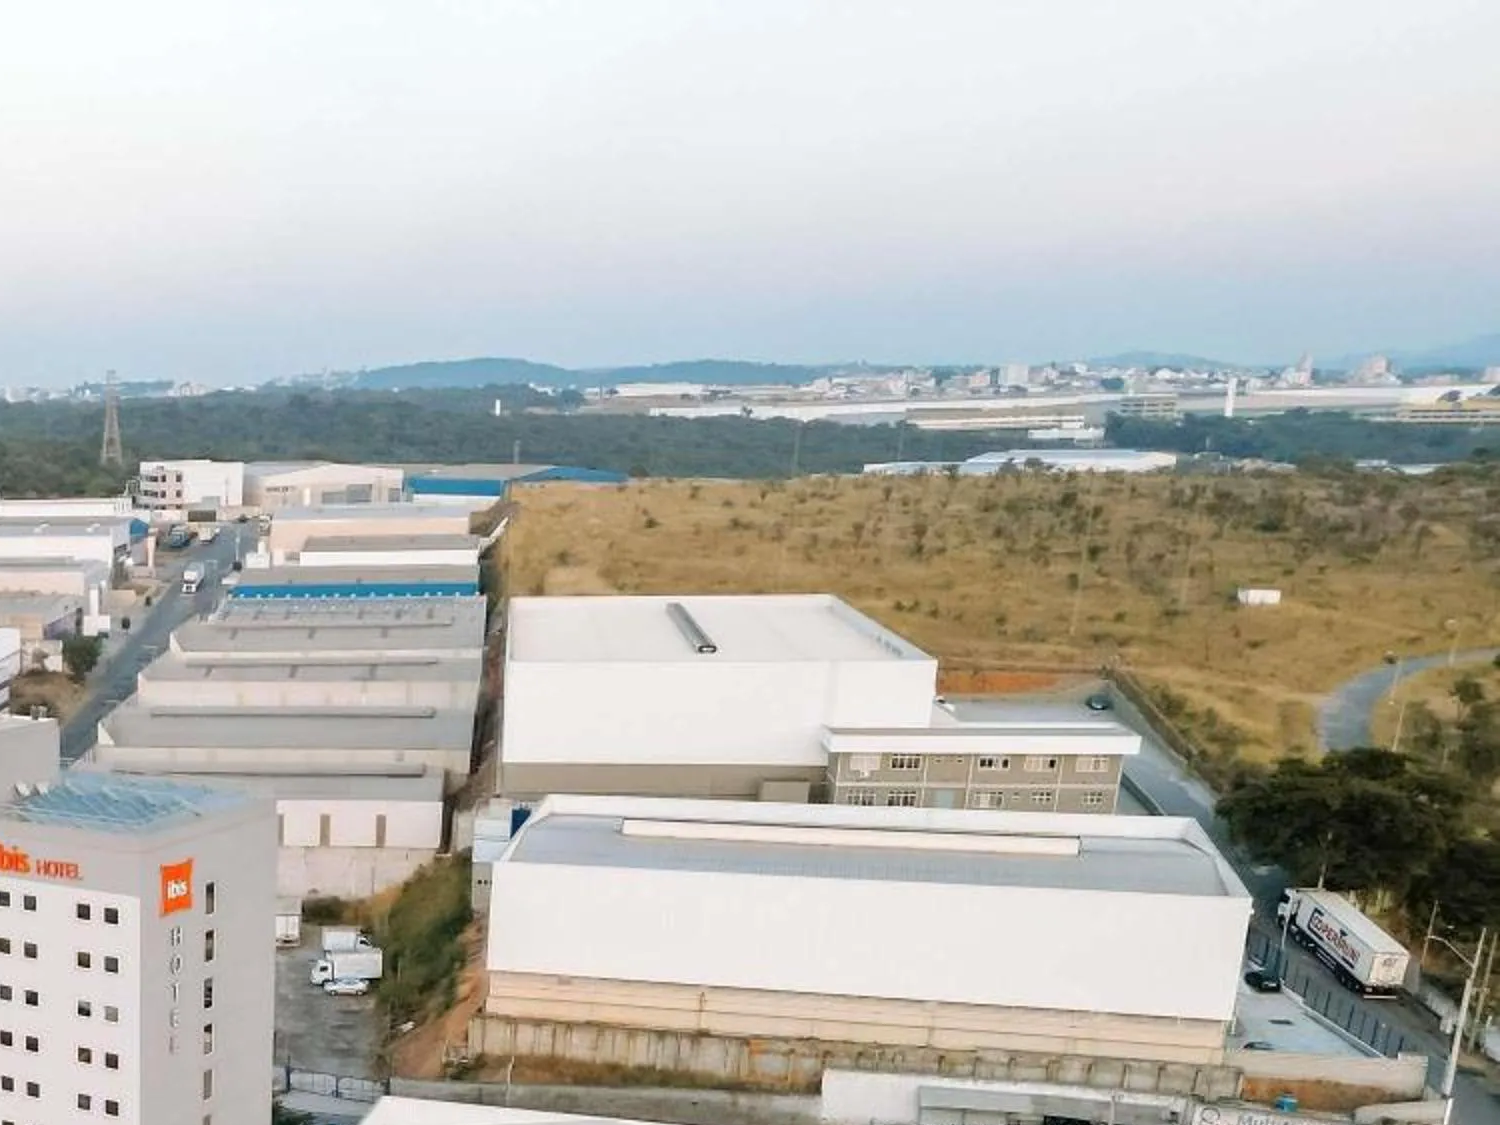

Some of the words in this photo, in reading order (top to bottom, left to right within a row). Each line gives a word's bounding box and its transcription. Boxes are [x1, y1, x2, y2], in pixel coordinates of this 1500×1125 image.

[36, 858, 83, 880] HOTEL
[167, 880, 188, 899] ibis
[169, 925, 183, 1055] HOTEL
